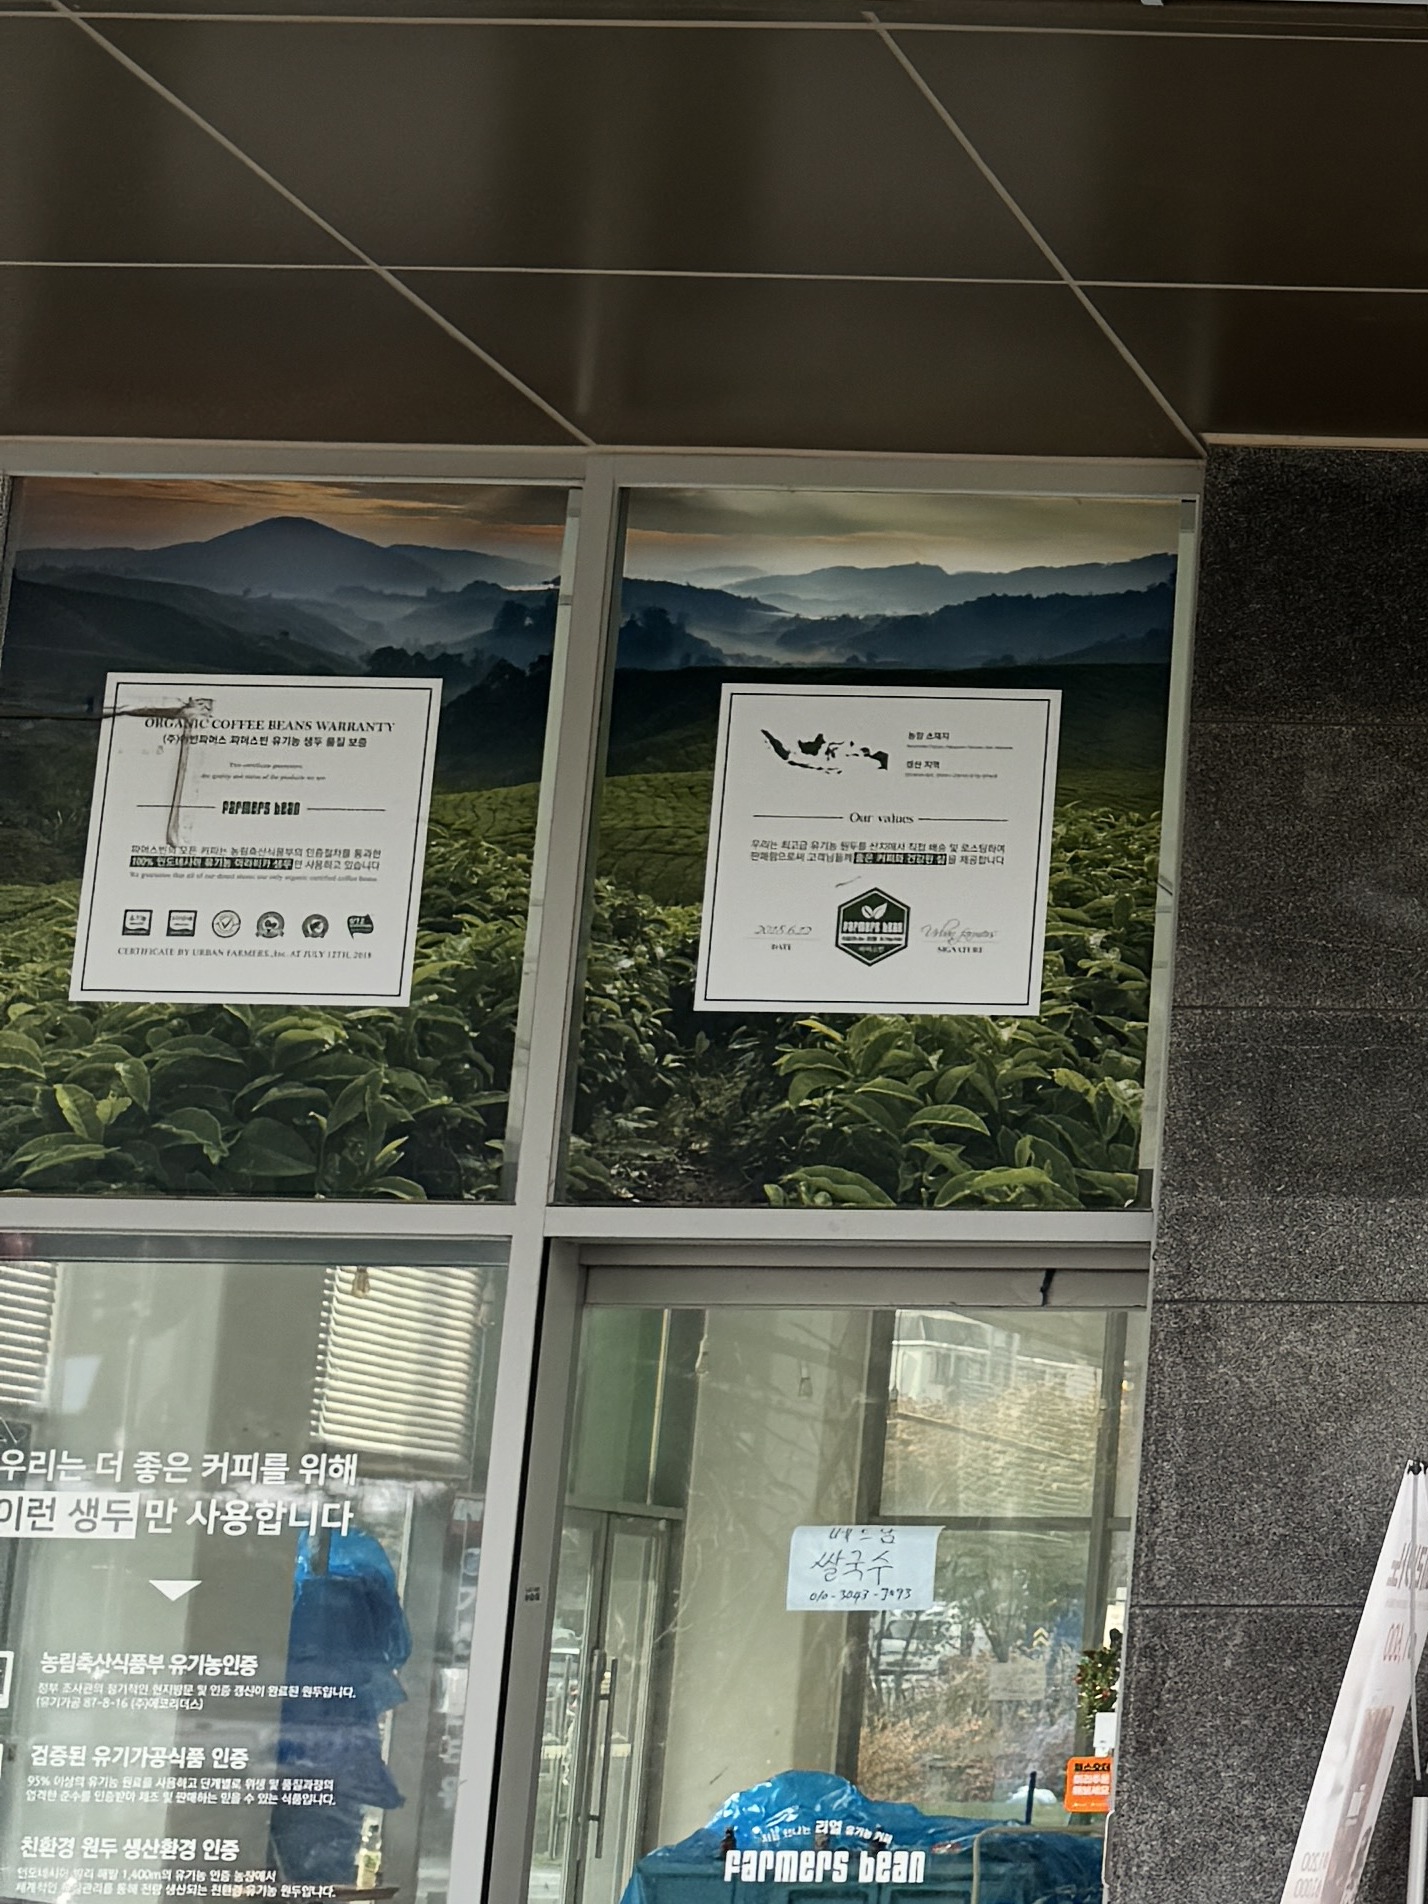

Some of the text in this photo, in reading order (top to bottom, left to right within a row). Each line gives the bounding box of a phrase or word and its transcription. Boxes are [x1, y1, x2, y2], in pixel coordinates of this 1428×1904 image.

[145, 718, 395, 732] ORGANIC COFFEE BEANS WARRANTY
[272, 736, 299, 747] 유기농
[850, 812, 914, 824] Our values
[0, 1449, 358, 1487] 우리는 더 좋은 커피를 위해
[0, 1496, 57, 1533] 이런
[67, 1497, 135, 1534] 생두
[186, 1499, 354, 1537] 사용합니다
[810, 1550, 894, 1585] 쌀국수
[40, 1652, 258, 1676] 농림축산식품부 유기농인증
[31, 1745, 249, 1770] 검증된 유기가공식품 인증
[815, 1820, 842, 1835] 리얼
[21, 1836, 240, 1861] 친환경 원두 생산환경 인증
